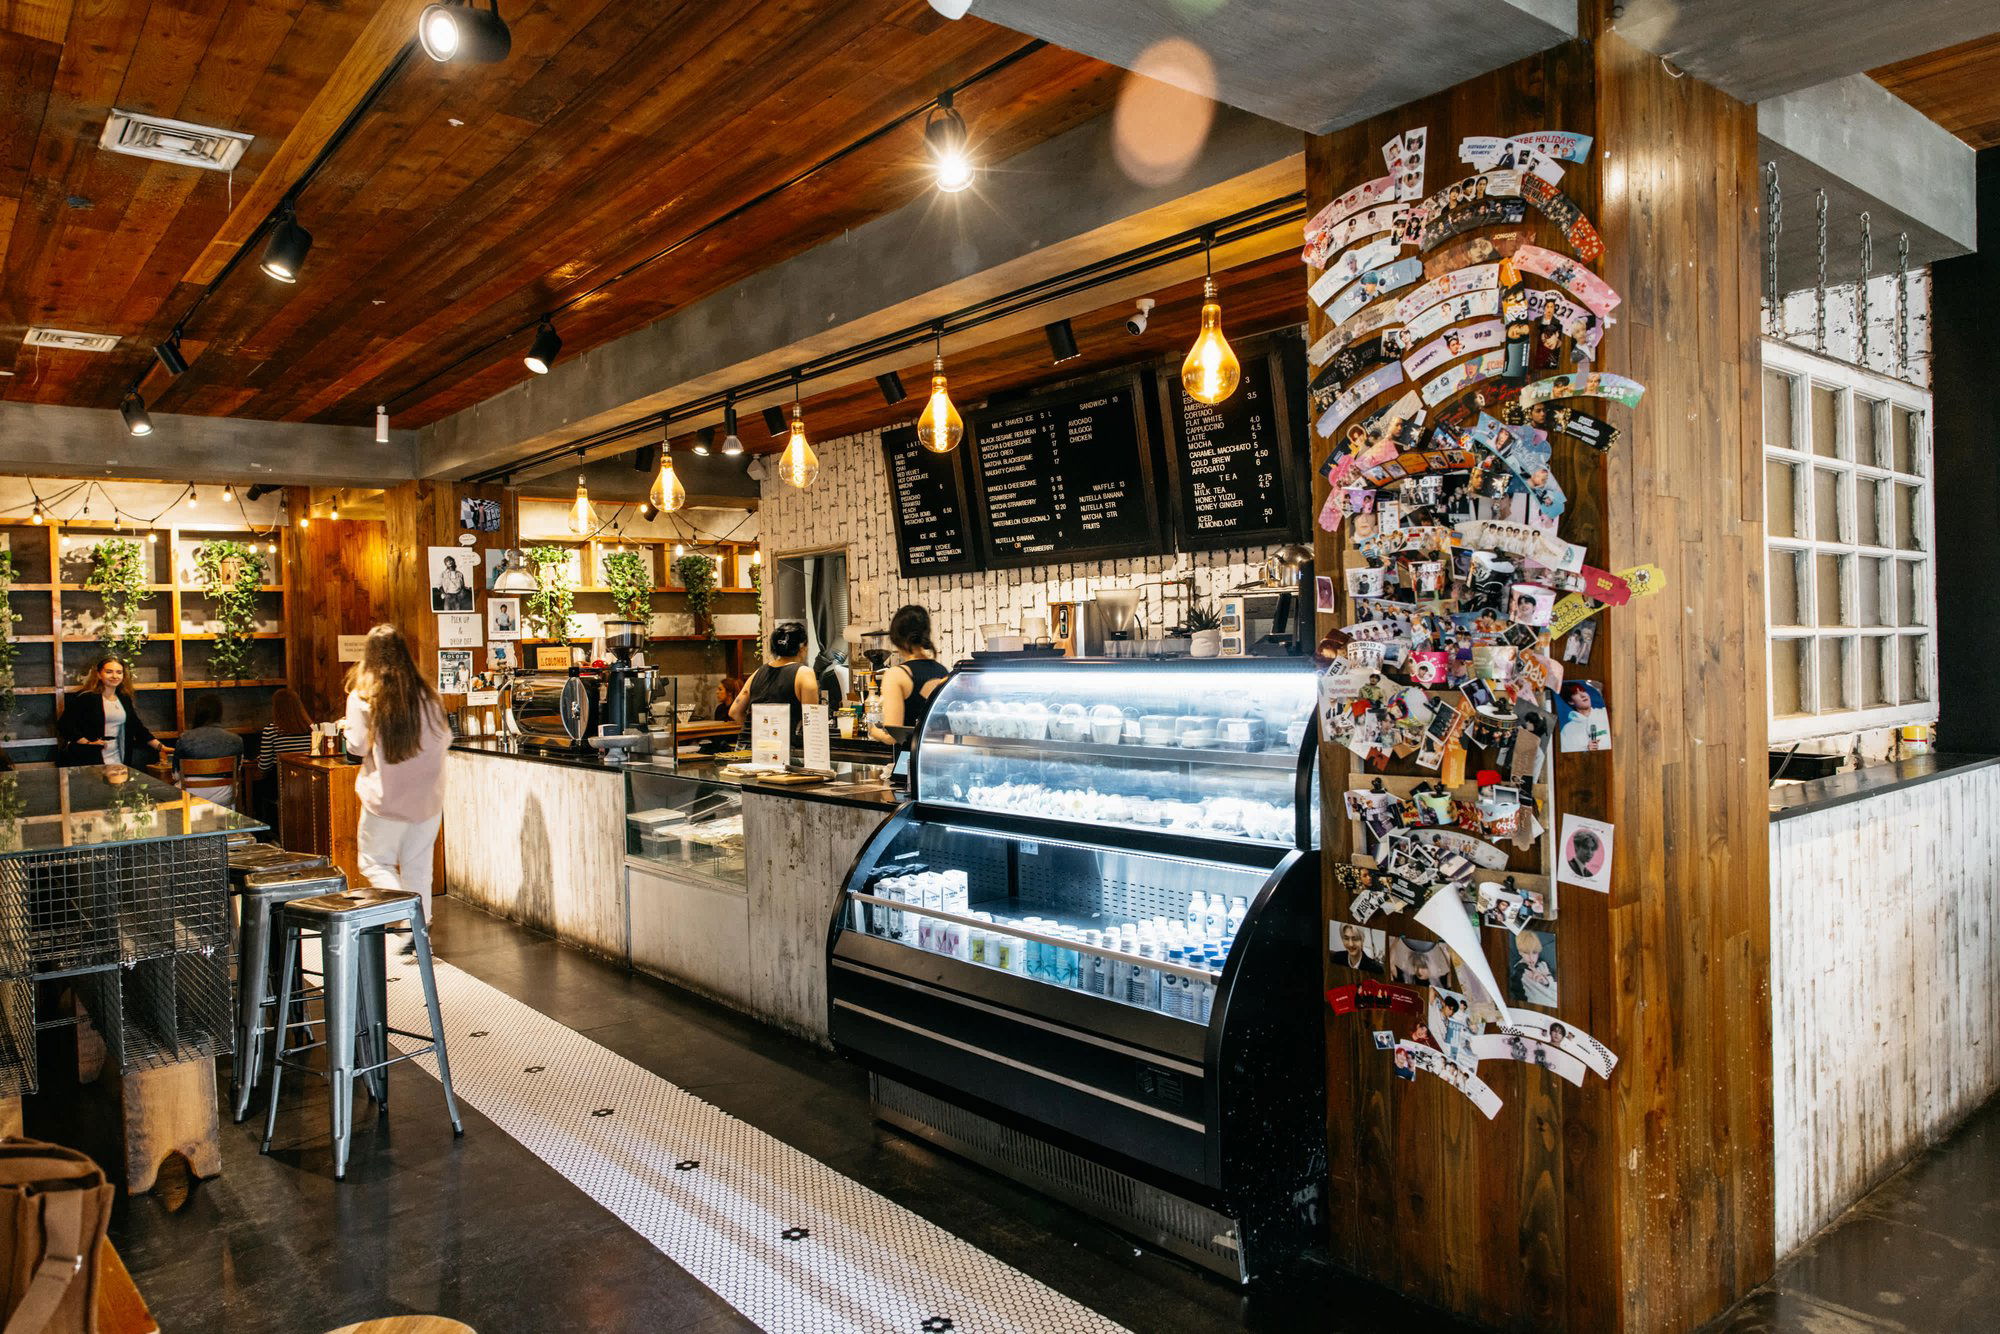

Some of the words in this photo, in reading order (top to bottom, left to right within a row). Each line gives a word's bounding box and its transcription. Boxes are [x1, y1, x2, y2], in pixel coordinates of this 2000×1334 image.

[1535, 135, 1577, 148] HOLIDAYS
[1246, 391, 1257, 400] 3.5
[1079, 398, 1108, 410] SANDWICH
[1184, 408, 1213, 420] CORTADO
[991, 422, 1003, 430] MILK
[1005, 417, 1024, 426] SHAVED
[1068, 417, 1092, 427] AVOCADO
[1186, 418, 1200, 427] FLAT
[1201, 414, 1223, 425] WHITE
[1186, 422, 1225, 435] CAPPUCCINO
[1250, 415, 1260, 423] 4.0
[1068, 425, 1092, 435] BULGOGI
[1187, 432, 1206, 442] LATTE
[1251, 423, 1261, 432] 4.5
[980, 437, 995, 445] BLACK
[995, 433, 1013, 442] SESAME
[1024, 428, 1037, 436] BEAN
[1070, 433, 1092, 443] CHICKEN
[1002, 437, 1032, 448] CHEESECAKE
[1188, 440, 1213, 450] MOCHA
[982, 451, 998, 460] CHOCO
[1000, 449, 1014, 457] OREO
[1189, 448, 1216, 459] CARAMEL
[1217, 442, 1251, 455] MACCHIATO
[984, 460, 1002, 468] MATCHA
[1190, 459, 1208, 468] COLD
[1212, 455, 1231, 465] BREW
[1254, 449, 1269, 458] 4.50
[1192, 464, 1226, 476] AFFOGATO
[1219, 473, 1238, 482] TEA
[1258, 473, 1273, 482] 2.75
[1007, 479, 1037, 490] CHEESECAKE
[1092, 482, 1115, 491] WAFFLE
[1079, 494, 1102, 502] NUTELLA
[1103, 491, 1124, 499] BANANA
[1194, 488, 1211, 496] MILK
[1195, 495, 1217, 504] HONEY
[1218, 493, 1236, 501] YUZU
[990, 502, 1007, 511] MATCHA
[1007, 498, 1037, 509] STRAWBERRY
[1080, 503, 1103, 512] NUTELLA
[1196, 503, 1218, 512] HONEY
[1219, 500, 1244, 509] GINGER
[1021, 514, 1051, 524] (SEASONAL)
[1197, 514, 1213, 522] ICED
[1023, 544, 1054, 553] STRAWBERRY
